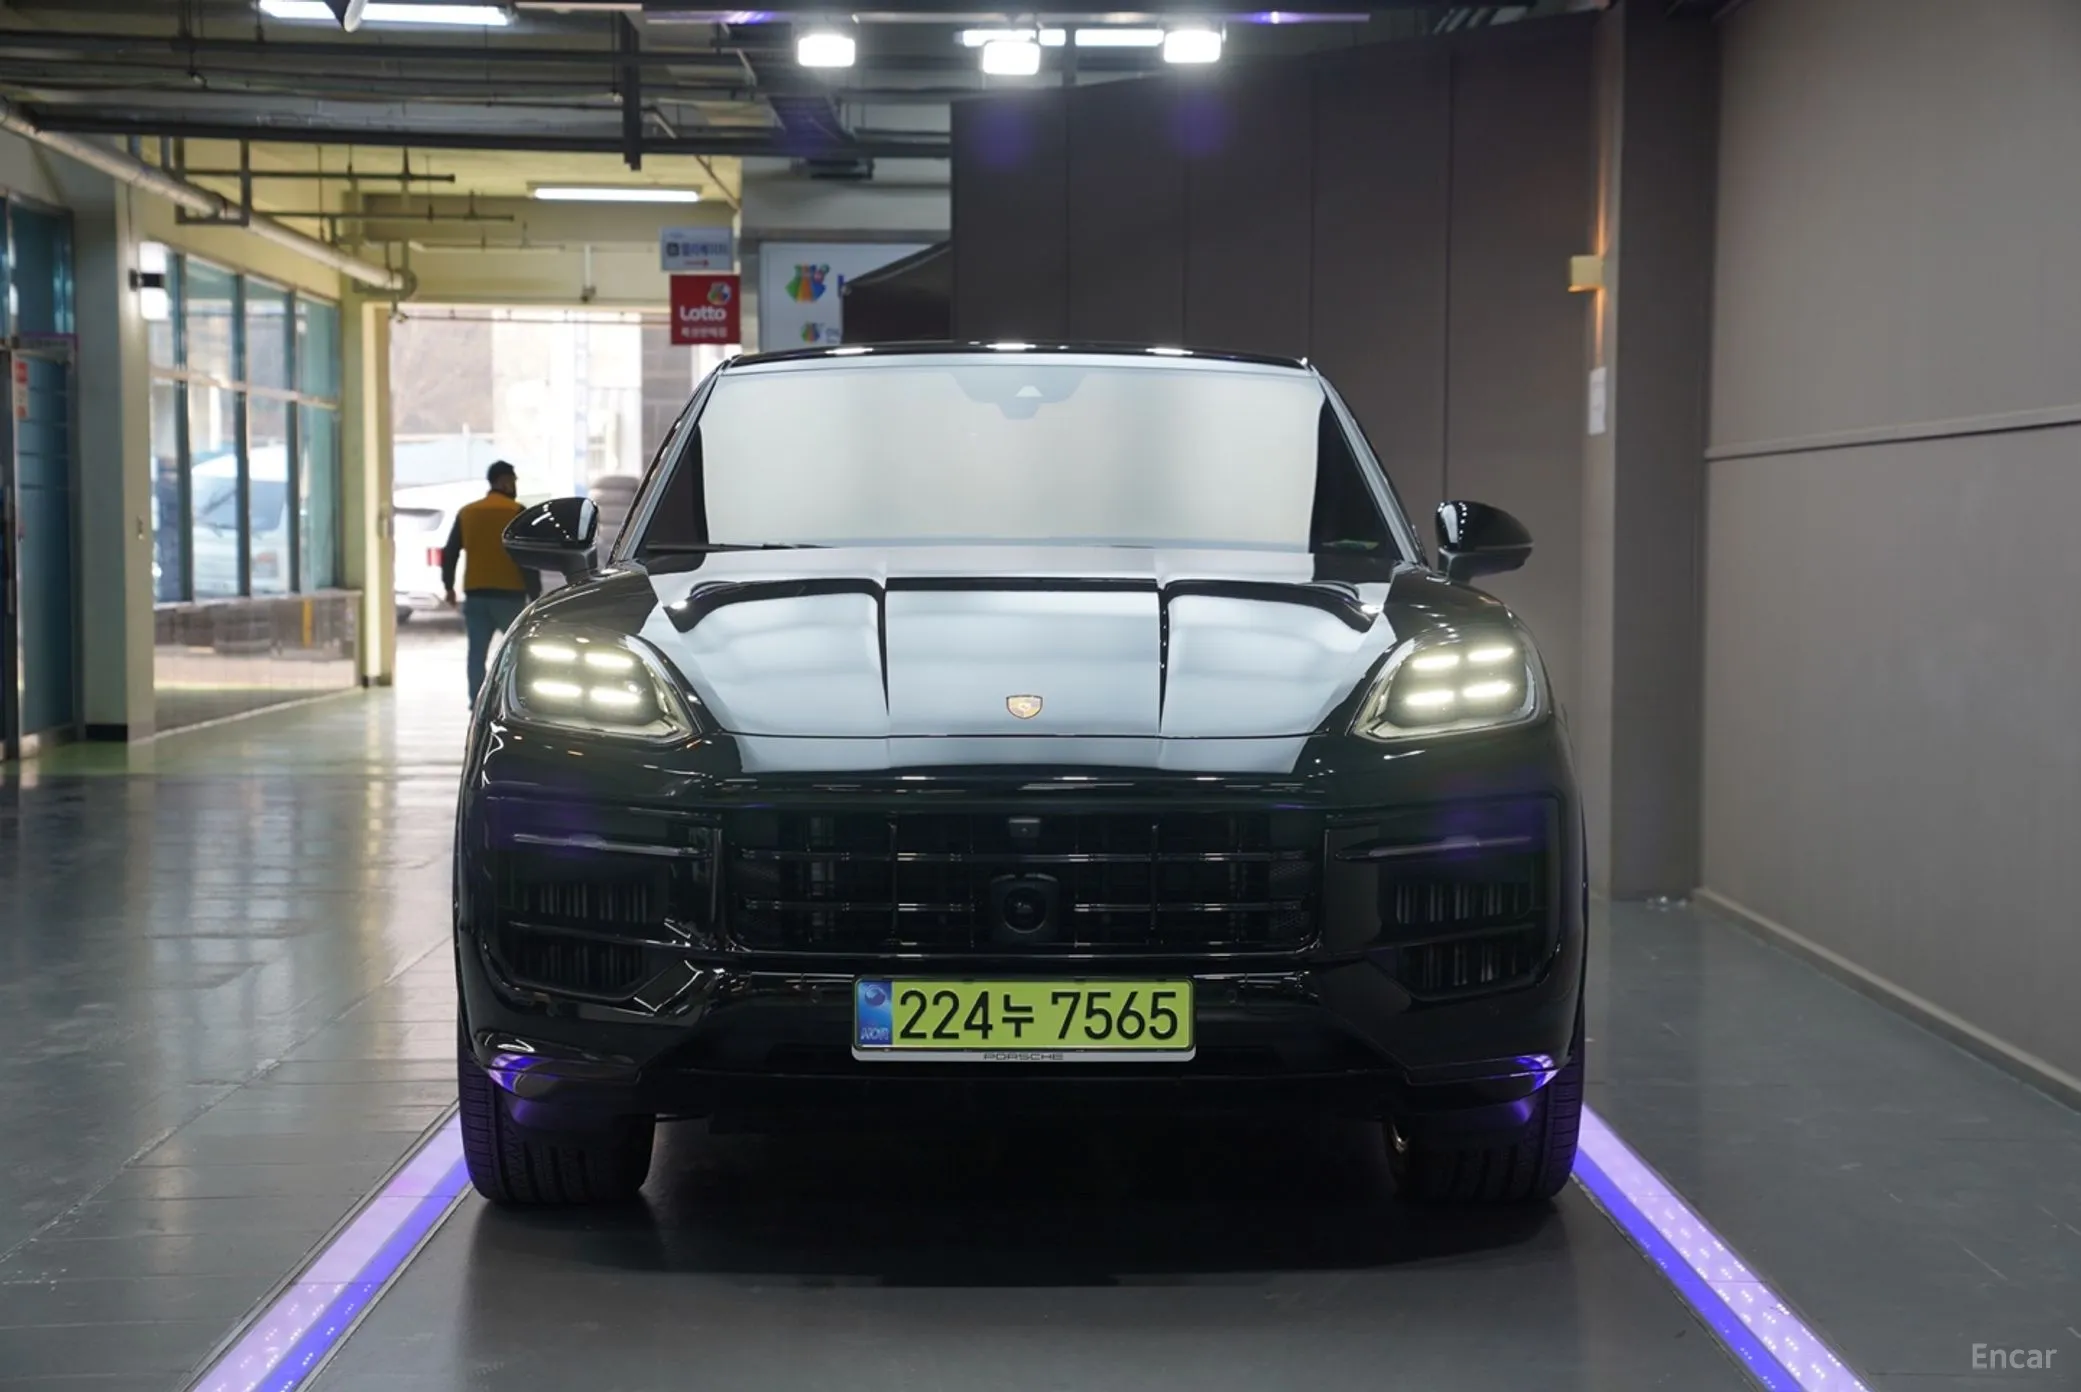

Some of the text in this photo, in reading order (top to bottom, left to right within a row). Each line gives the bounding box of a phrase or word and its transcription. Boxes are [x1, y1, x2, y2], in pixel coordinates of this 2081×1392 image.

[680, 305, 727, 321] Lotto
[900, 990, 1178, 1040] 224누 7565
[984, 1052, 1064, 1061] PORSCHE
